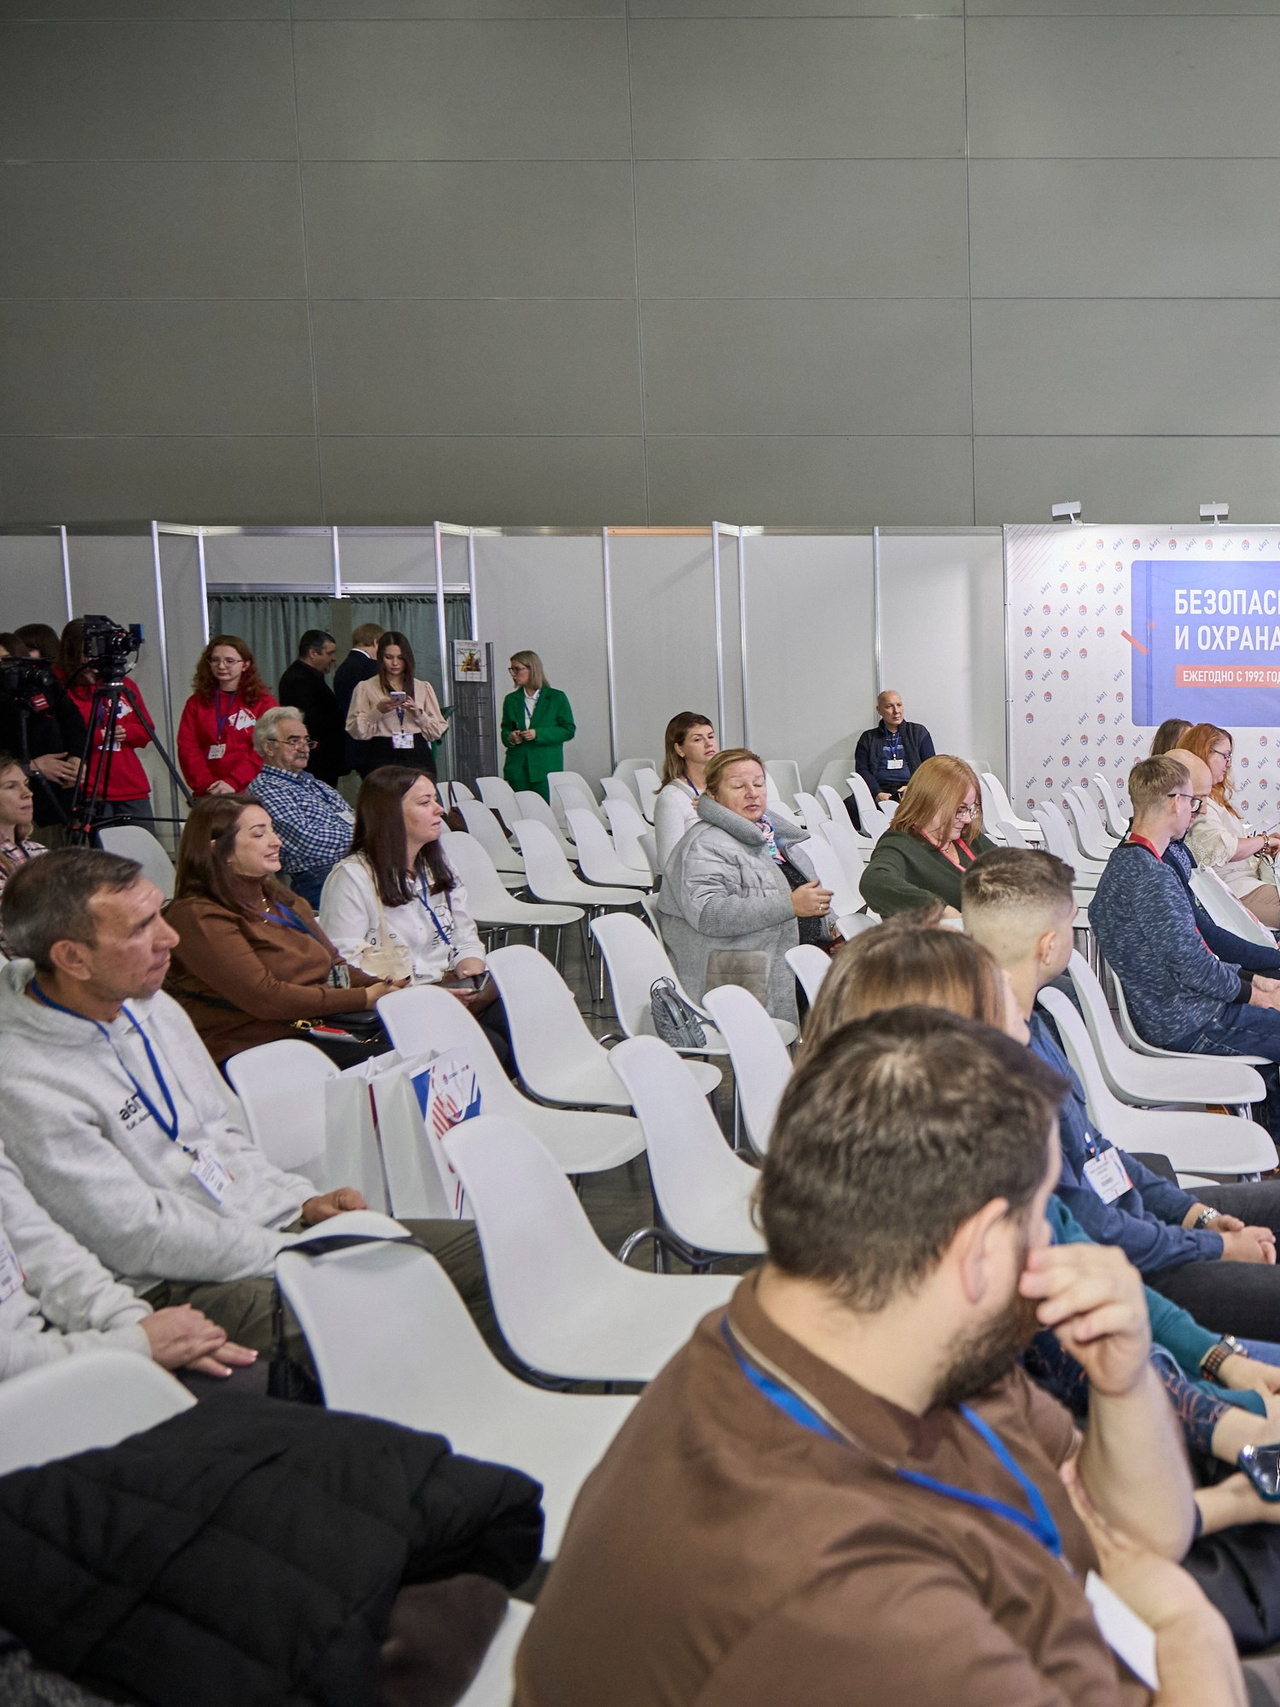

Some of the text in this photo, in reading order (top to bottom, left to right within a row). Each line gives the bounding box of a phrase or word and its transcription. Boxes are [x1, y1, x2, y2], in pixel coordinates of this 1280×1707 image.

[1175, 625, 1189, 651] И
[1183, 670, 1234, 683] ЕЖЕГОДНО
[1236, 670, 1243, 682] С
[1245, 670, 1264, 682] 1992
